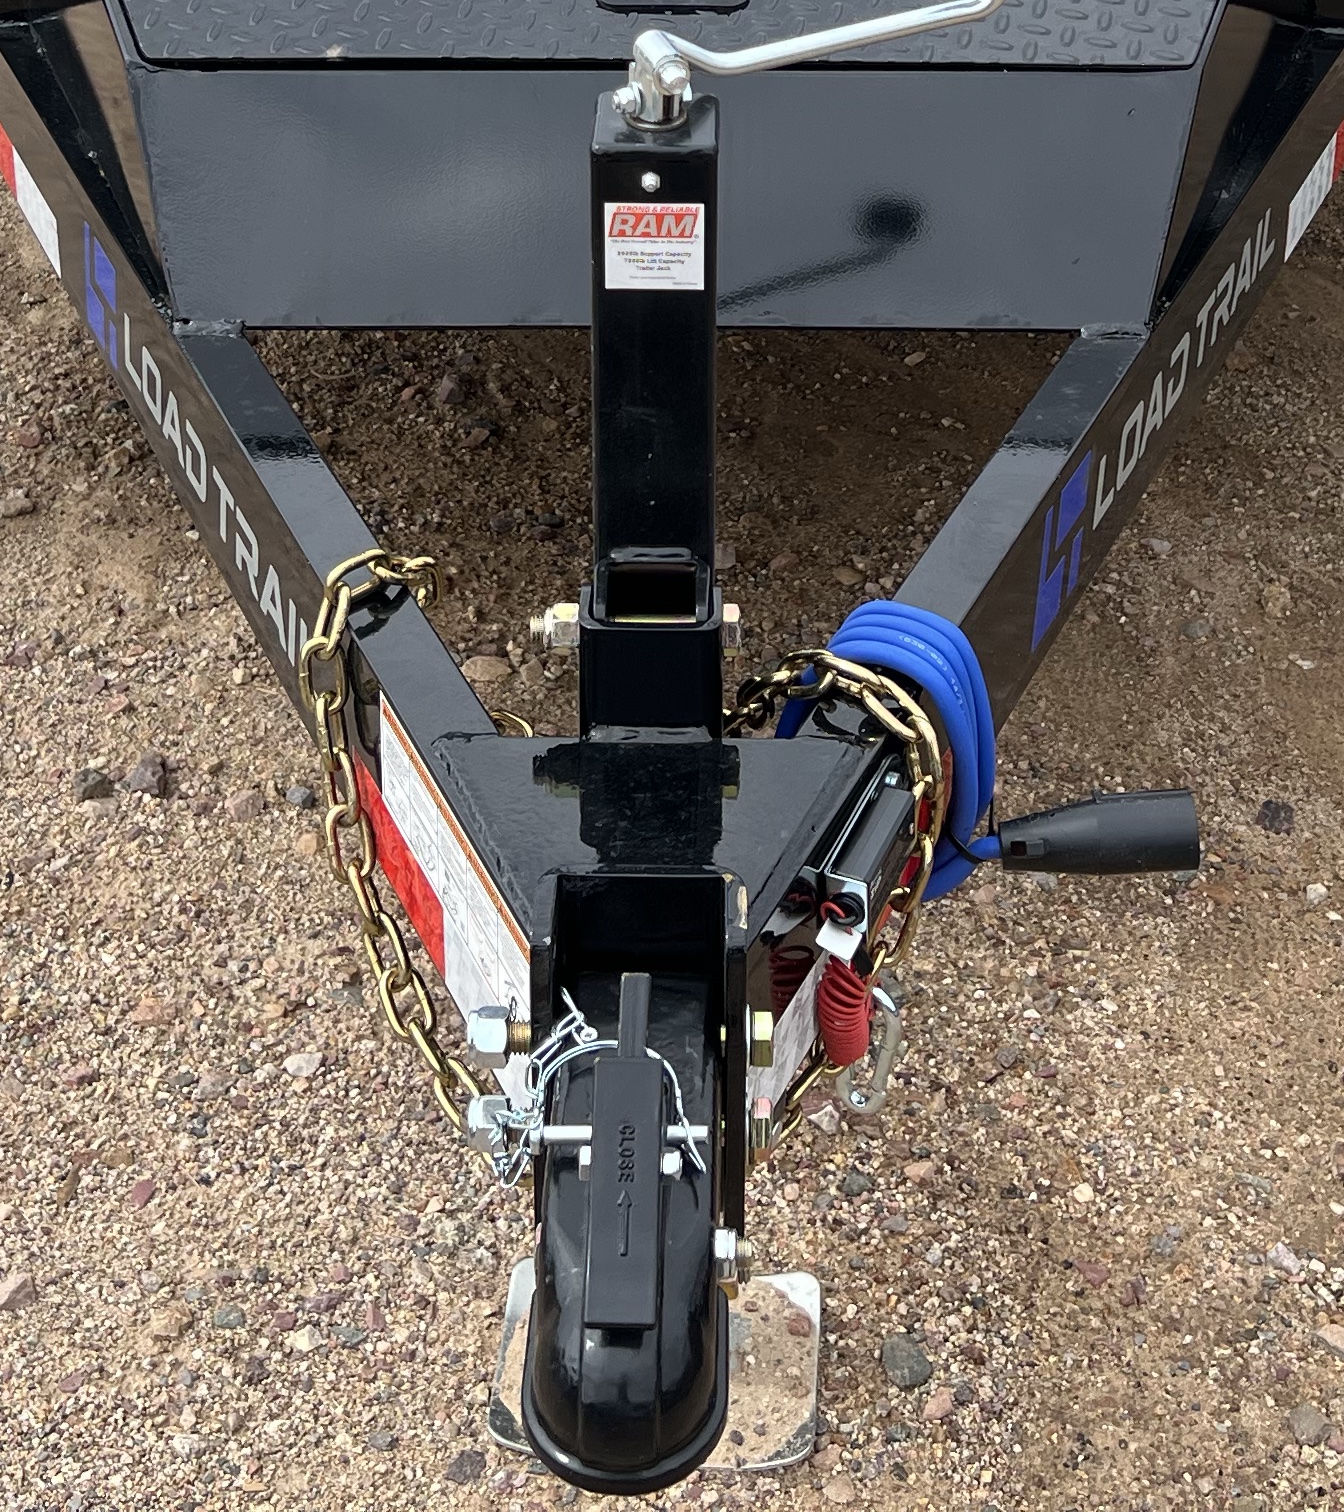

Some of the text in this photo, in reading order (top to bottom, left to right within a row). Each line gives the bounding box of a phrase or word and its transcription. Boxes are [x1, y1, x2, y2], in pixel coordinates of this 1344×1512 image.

[611, 214, 695, 238] RAM
[616, 205, 651, 213] STRONG
[659, 206, 701, 214] RELIABLE
[1091, 206, 1277, 532] LOAD TRAIL
[122, 311, 208, 504] LOAD
[617, 1123, 637, 1184] CLOSE
